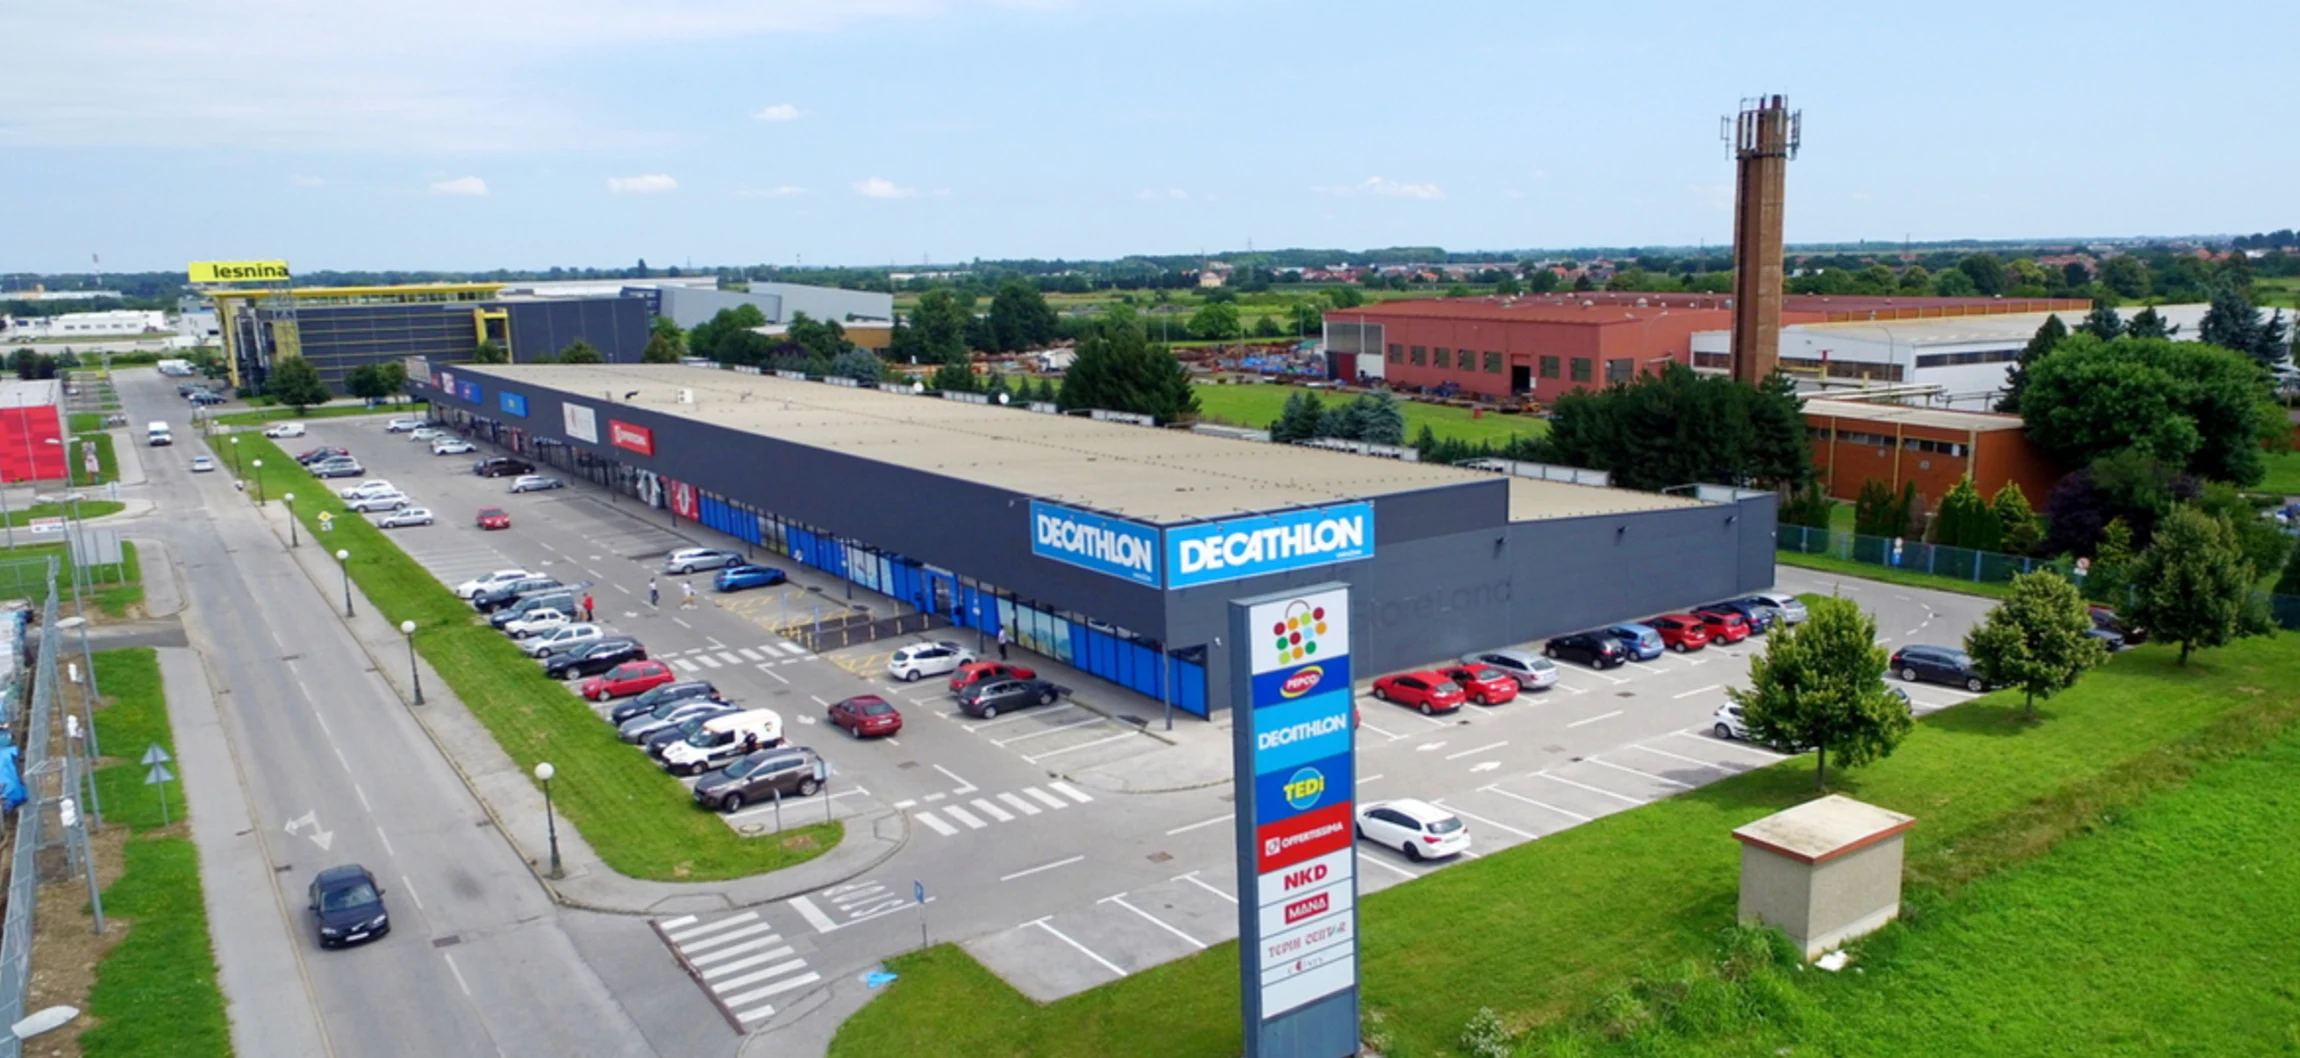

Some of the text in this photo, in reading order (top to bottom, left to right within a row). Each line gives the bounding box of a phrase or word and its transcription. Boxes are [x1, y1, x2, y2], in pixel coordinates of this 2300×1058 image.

[213, 263, 288, 278] lesnina
[1037, 513, 1153, 573] DECATHLON
[1179, 516, 1363, 574] DECATHLON
[1286, 674, 1320, 690] PEPCO
[1258, 713, 1347, 750] DECATHLON
[1283, 775, 1324, 801] TEDi
[1284, 864, 1328, 890] NKD
[1289, 897, 1327, 919] MANA
